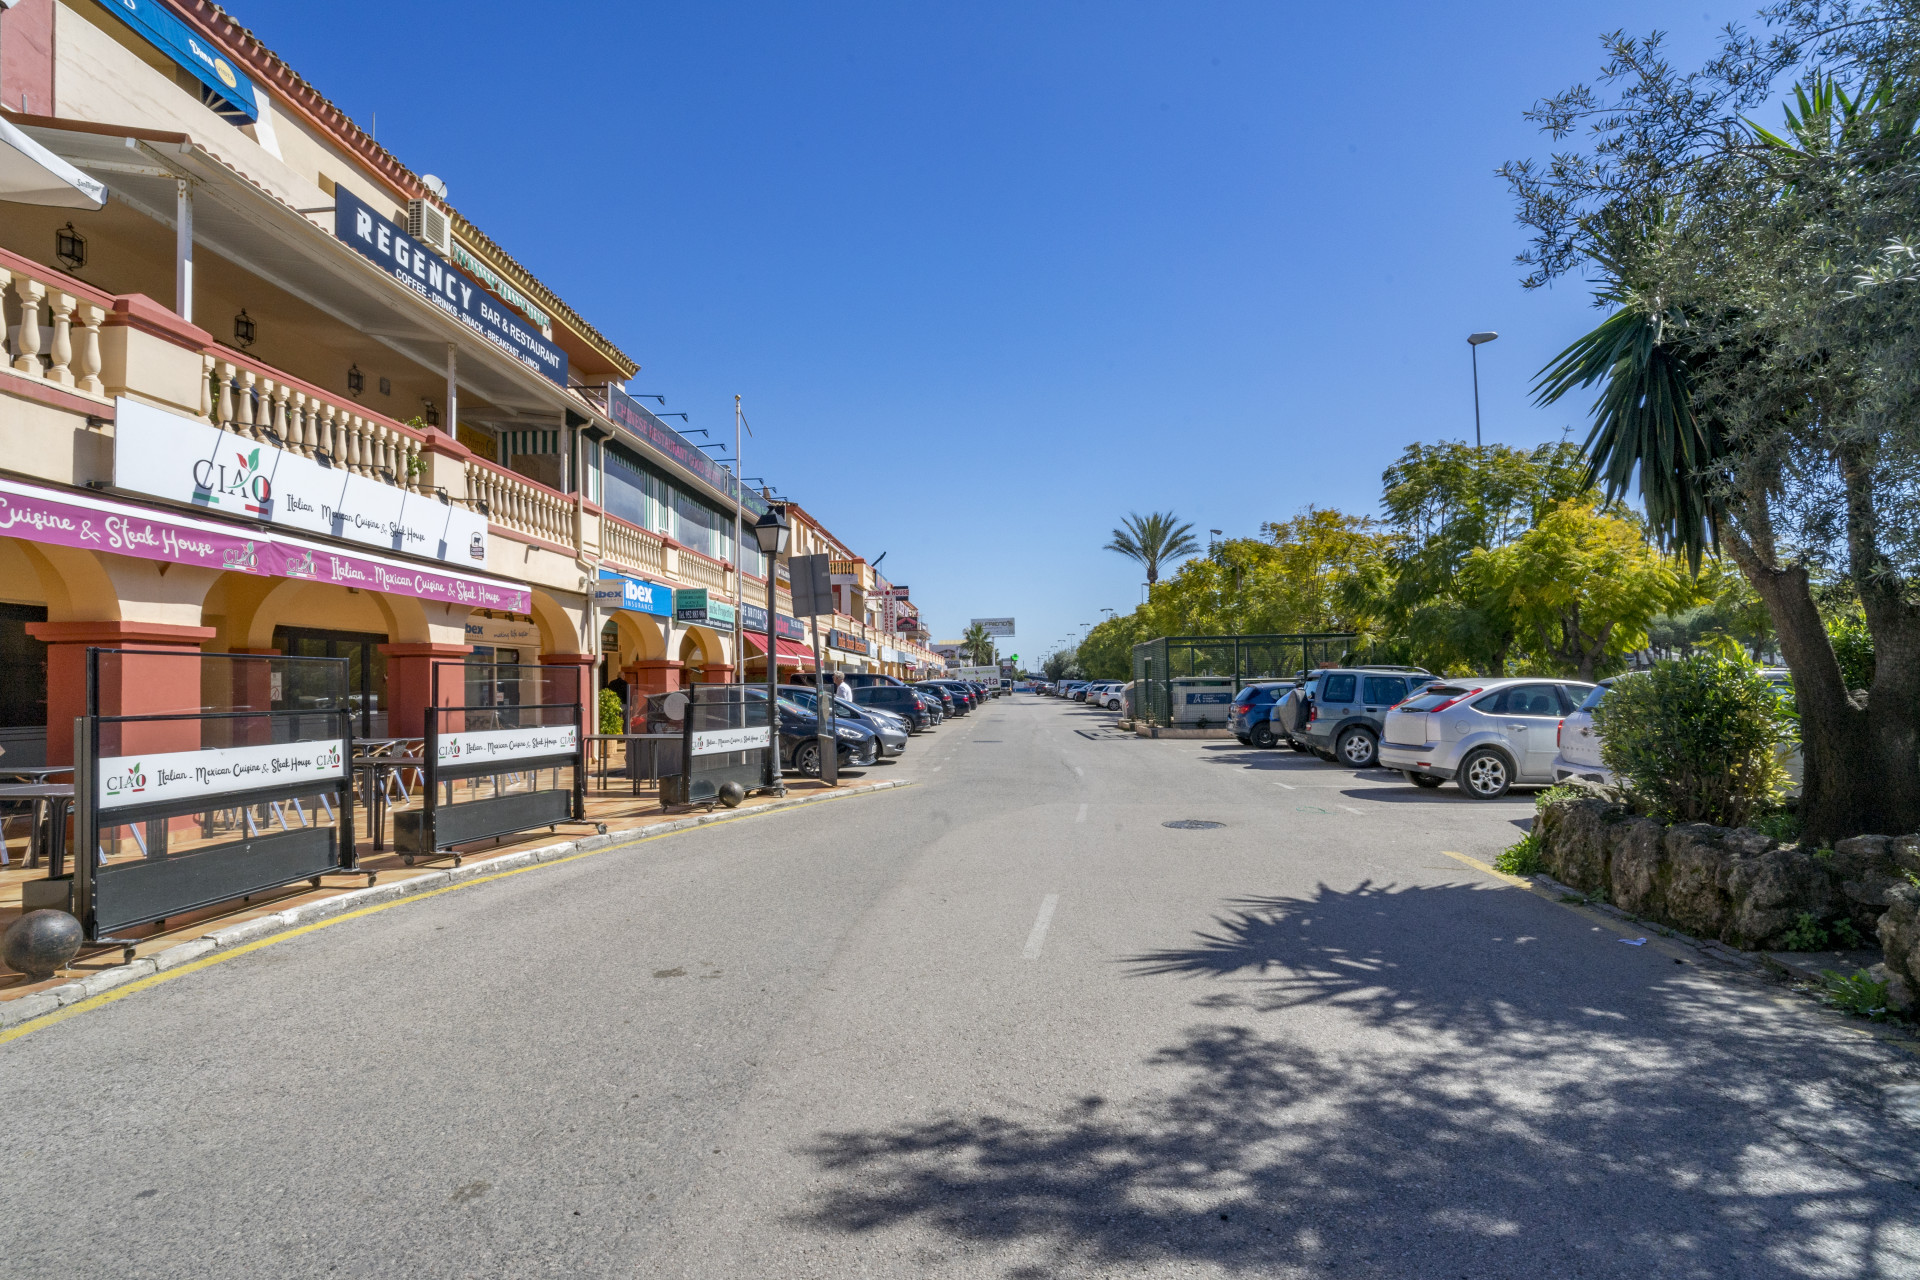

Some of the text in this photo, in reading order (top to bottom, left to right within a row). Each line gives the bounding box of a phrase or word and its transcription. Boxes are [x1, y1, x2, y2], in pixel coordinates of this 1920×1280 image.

[357, 207, 472, 310] REGENCY
[396, 268, 428, 298] COFFEE
[432, 292, 458, 318] DRINKS
[462, 313, 484, 335] SNACK
[487, 331, 520, 360] BREAKFAST
[522, 353, 540, 372] LUNCH
[481, 302, 560, 369] BAR & RESTAURANT
[615, 400, 648, 435] CHINESE
[649, 423, 688, 464] RESTAURANT
[688, 453, 705, 475] GOOD
[193, 459, 271, 503] CIAO
[286, 493, 425, 543] Italian Mexican Cuisine & Steak House
[80, 519, 101, 544] &
[105, 516, 159, 549] Steak
[162, 529, 215, 559] House
[223, 548, 259, 567] CIAO
[286, 557, 318, 575] CIAO
[330, 556, 366, 581] Italian
[374, 566, 412, 591] Mexican
[414, 575, 445, 594] Cuisine
[448, 583, 456, 598] &
[456, 581, 477, 602] Steak
[478, 586, 501, 604] House
[594, 590, 622, 598] ibex
[624, 580, 653, 604] ibex
[625, 600, 653, 612] INSURANCE
[747, 607, 762, 620] BRITISH
[465, 623, 484, 635] bex
[439, 745, 460, 756] CIAO
[466, 742, 483, 755] Italian
[560, 735, 576, 745] CIAO
[107, 773, 147, 790] CIAO
[157, 769, 187, 787] Italian
[195, 767, 231, 785] Mexican
[233, 762, 261, 778] Cuisine
[261, 763, 269, 774] &
[271, 758, 290, 774] Steak
[290, 757, 312, 772] House
[316, 752, 341, 767] CIAO
